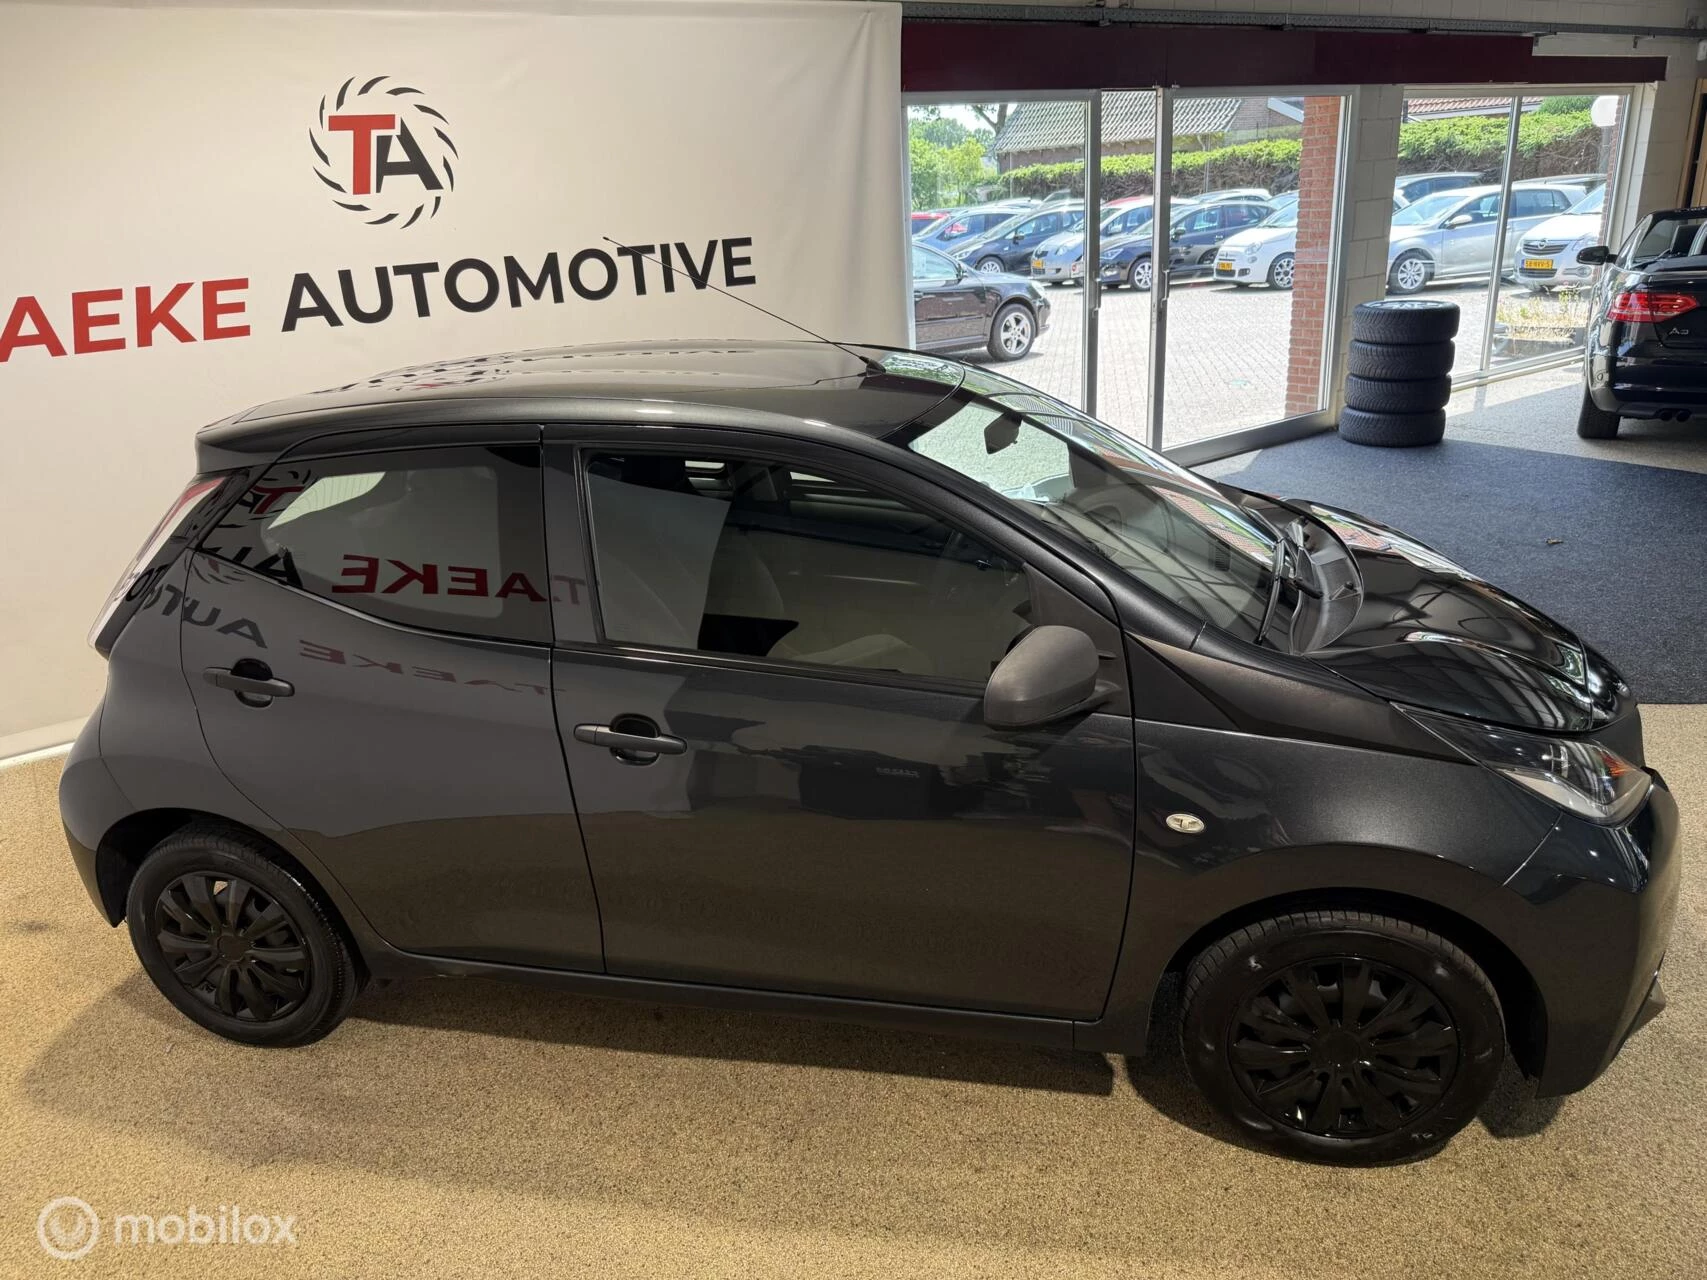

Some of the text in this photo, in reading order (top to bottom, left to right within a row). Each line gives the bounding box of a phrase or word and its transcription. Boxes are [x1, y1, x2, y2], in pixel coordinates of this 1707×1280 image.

[328, 114, 444, 195] TA
[0, 236, 757, 363] AEKE AUTOMOTIVE
